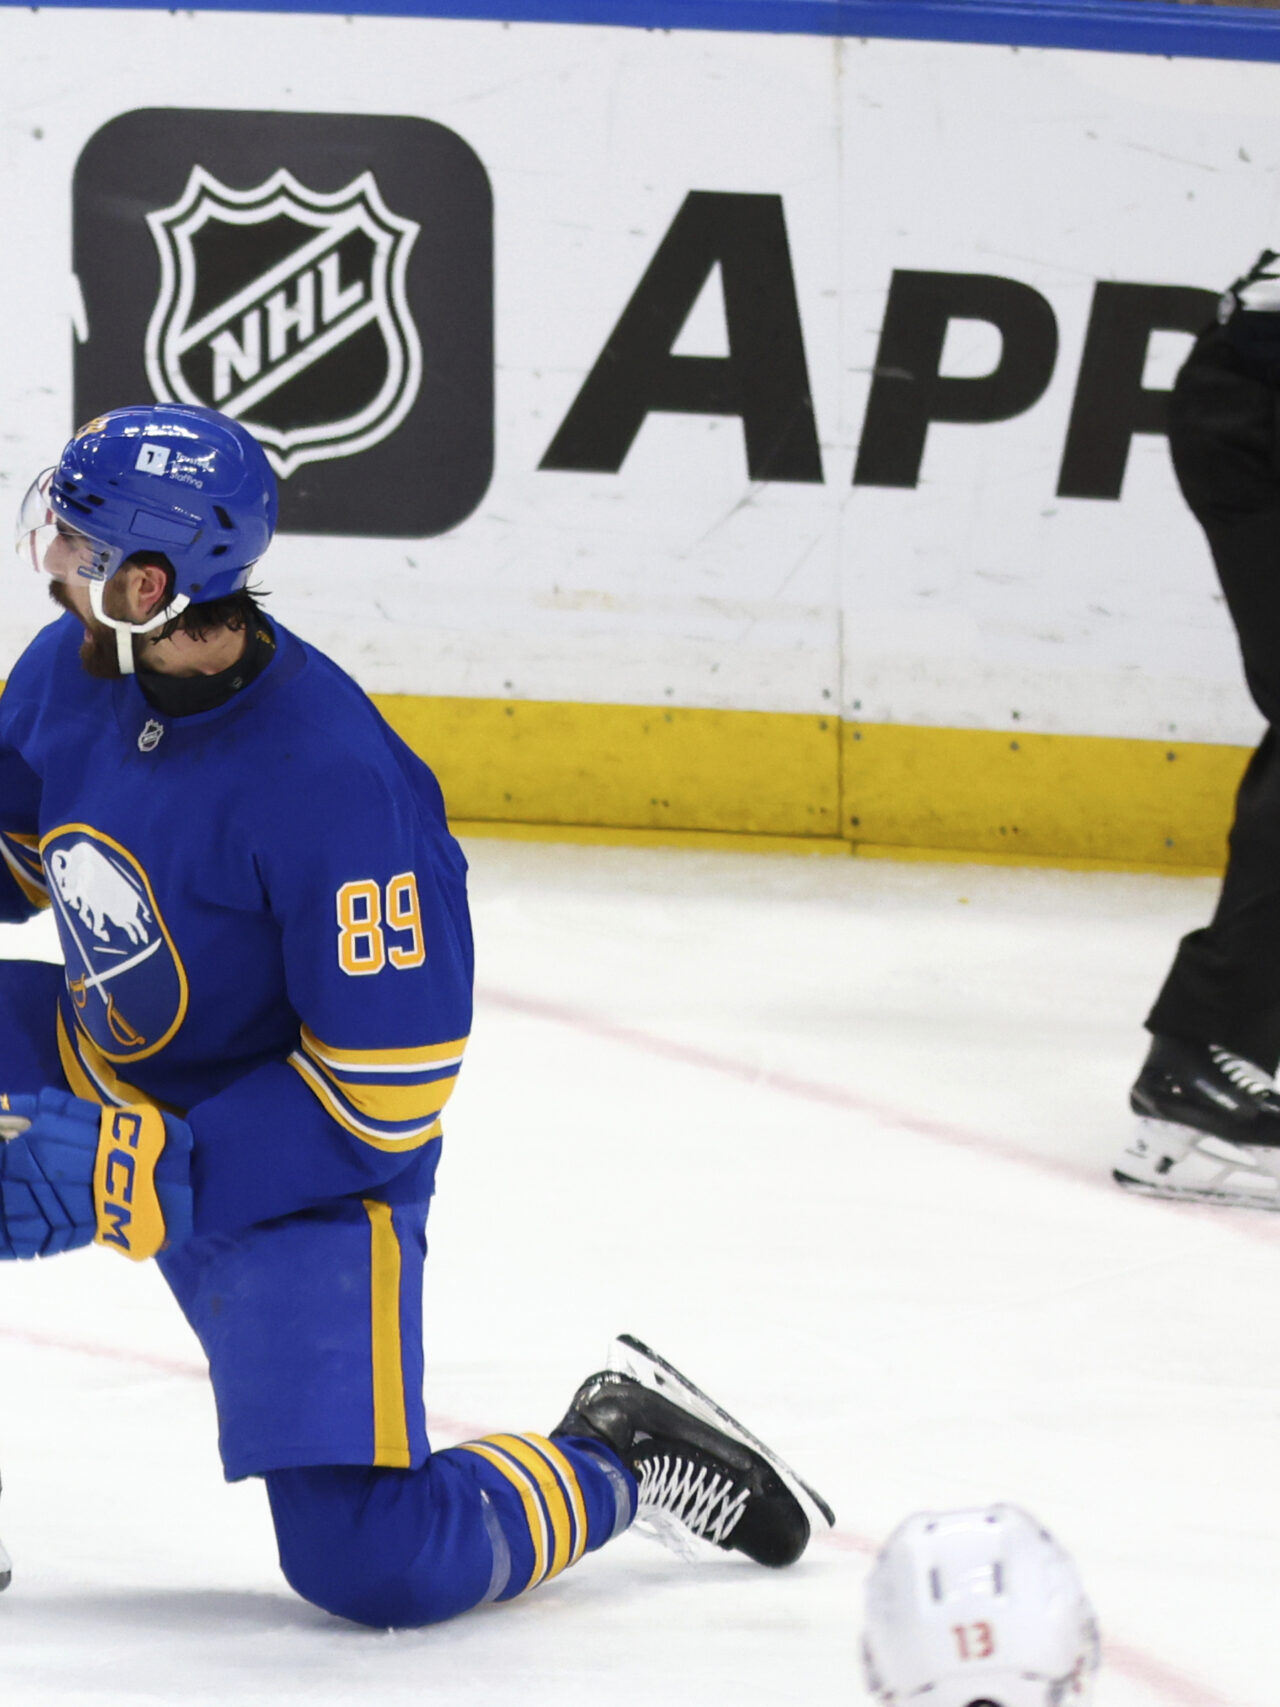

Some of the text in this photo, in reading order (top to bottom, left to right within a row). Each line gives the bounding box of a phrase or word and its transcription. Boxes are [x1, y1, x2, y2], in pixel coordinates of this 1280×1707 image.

[208, 251, 364, 402] NHL
[336, 871, 426, 977] 89
[103, 1112, 142, 1251] CCM
[952, 1621, 995, 1662] 13
